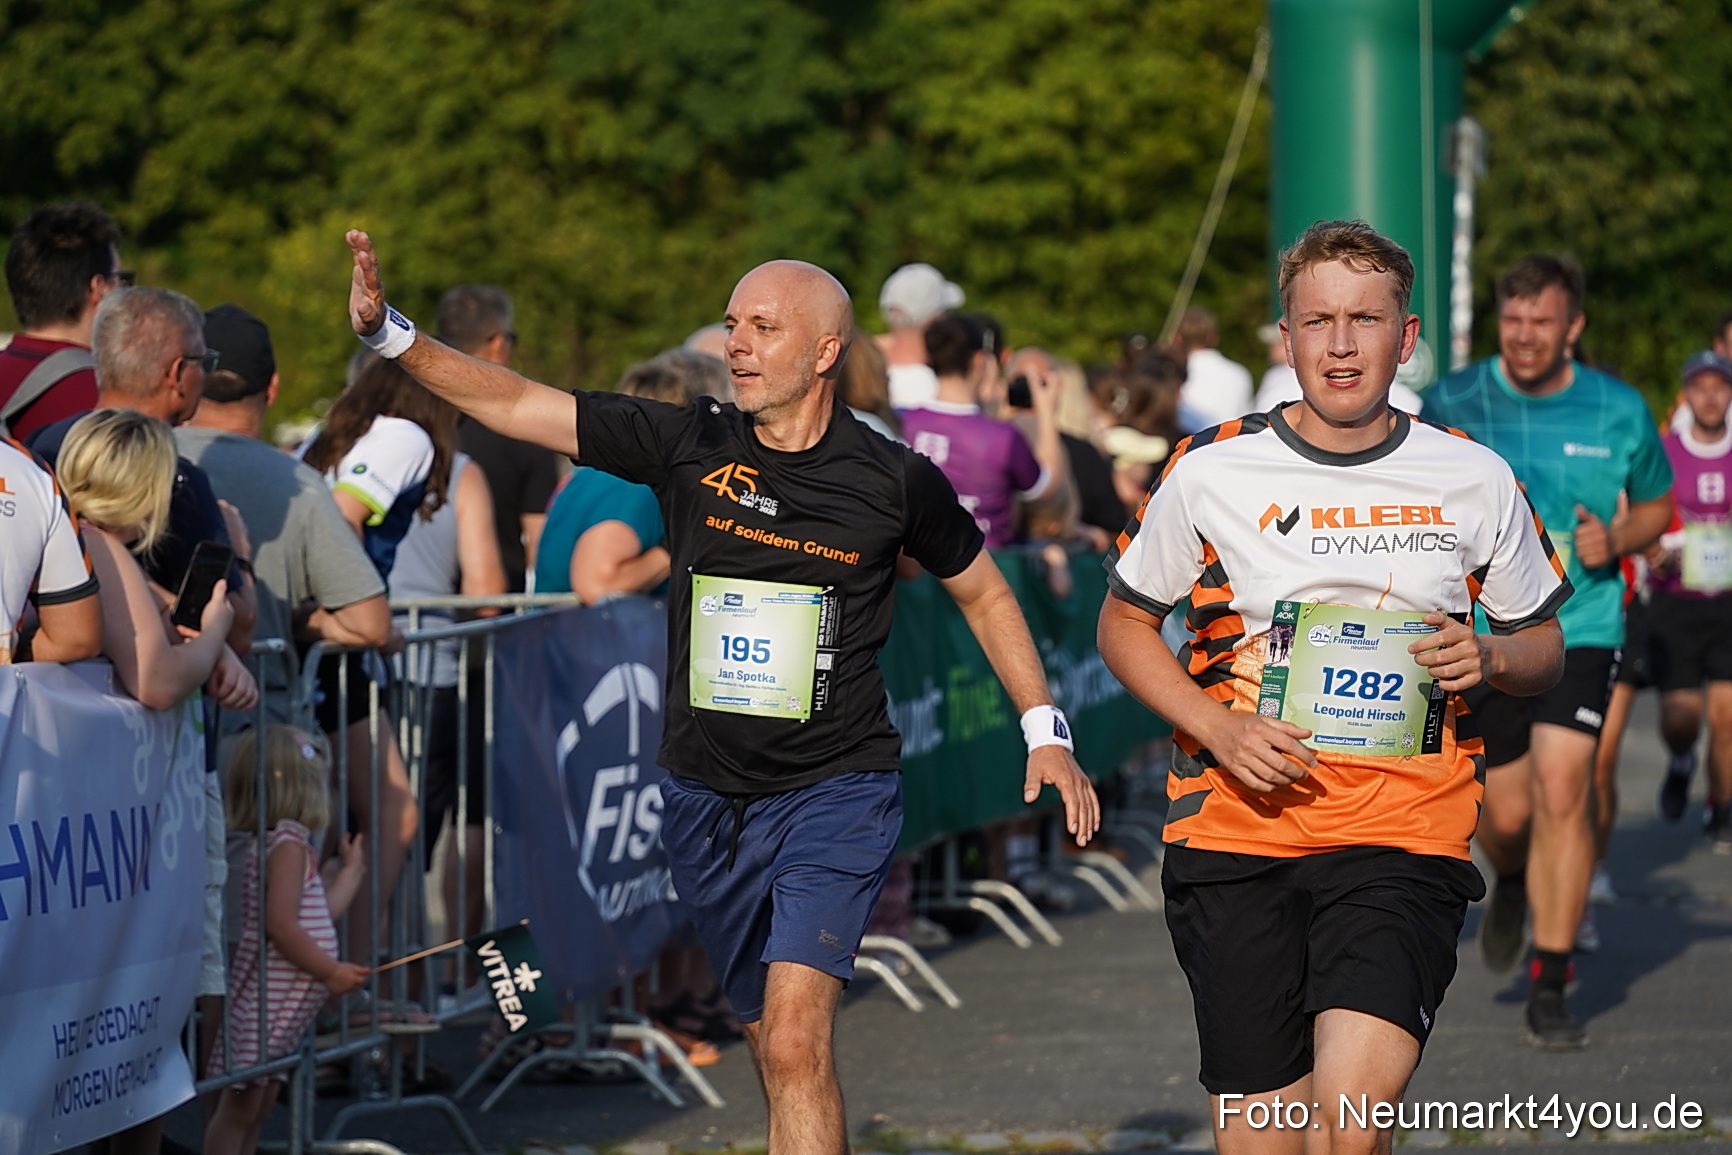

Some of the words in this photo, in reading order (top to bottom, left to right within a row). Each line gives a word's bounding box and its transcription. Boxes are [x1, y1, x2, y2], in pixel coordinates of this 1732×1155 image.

[700, 462, 760, 502] 45
[0, 500, 16, 518] S
[740, 489, 779, 510] JAHRE
[1311, 505, 1456, 529] KLEBL
[705, 516, 734, 532] auf
[734, 524, 799, 551] solidem
[803, 540, 861, 566] Grund!
[1311, 532, 1458, 555] DYNAMICS
[717, 605, 758, 615] Firmenlauf
[820, 595, 829, 627] RABATT
[1275, 611, 1295, 620] AOK
[721, 634, 772, 665] 195
[1332, 635, 1381, 647] Firmenlauf
[718, 668, 734, 680] Jan
[736, 670, 776, 684] Spotka
[1322, 666, 1405, 702] 1282
[814, 673, 827, 711] HILTL
[1314, 702, 1365, 719] Leopold
[1367, 708, 1406, 722] Hirsch
[1426, 703, 1439, 744] HILTL
[477, 939, 528, 1032] VITREA
